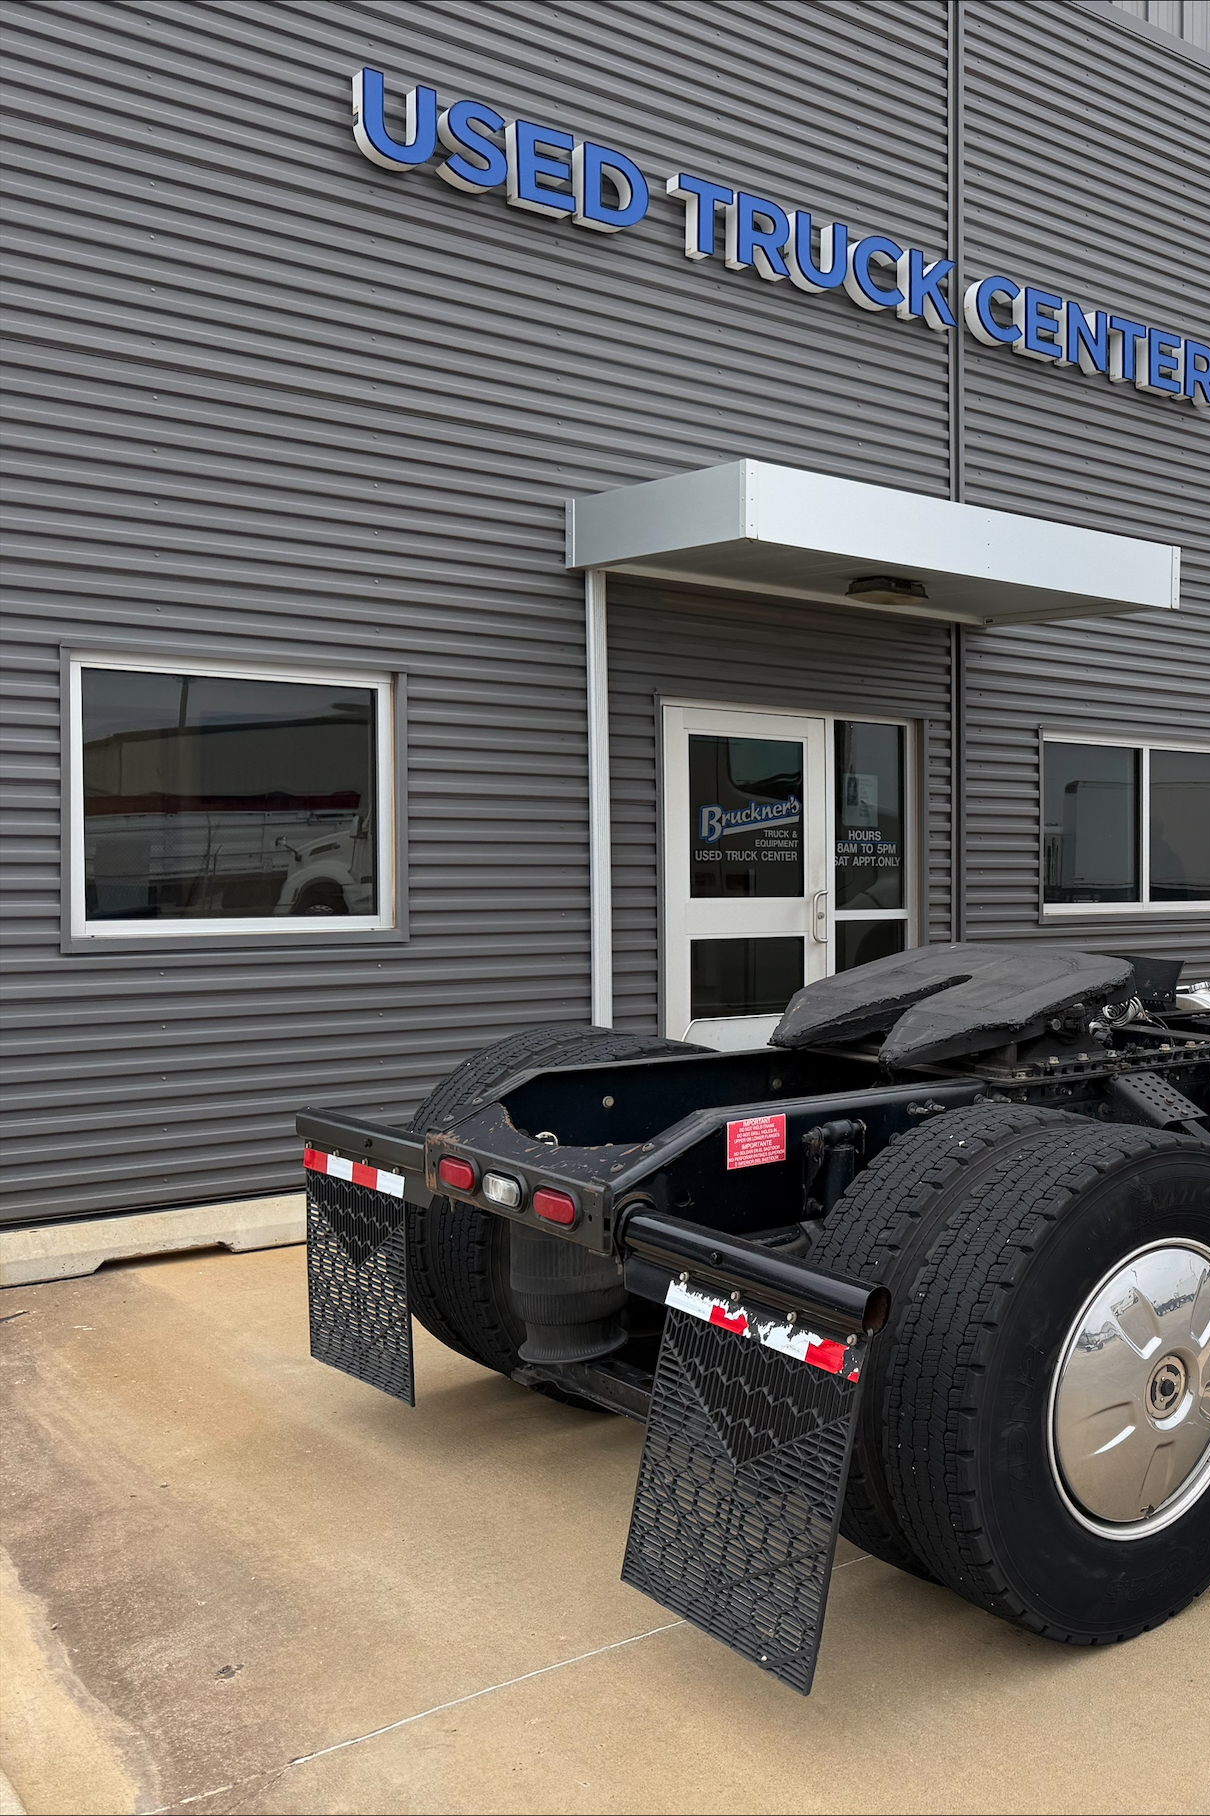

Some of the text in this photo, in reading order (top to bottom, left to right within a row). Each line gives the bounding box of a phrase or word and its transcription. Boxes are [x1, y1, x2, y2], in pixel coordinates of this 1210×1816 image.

[352, 67, 649, 232] USED
[667, 173, 957, 330] TRUCK
[700, 795, 801, 843] Bruckner's
[764, 830, 798, 838] TRUCK &
[848, 830, 882, 842] HOURS
[755, 840, 799, 848] EQUIPMENT
[836, 843, 896, 854] 8AM TO 5PM
[695, 850, 798, 861] USED TRUCK CENTER
[743, 1117, 770, 1127] IMPORTANT
[742, 1140, 772, 1150] IMPORTANTE
